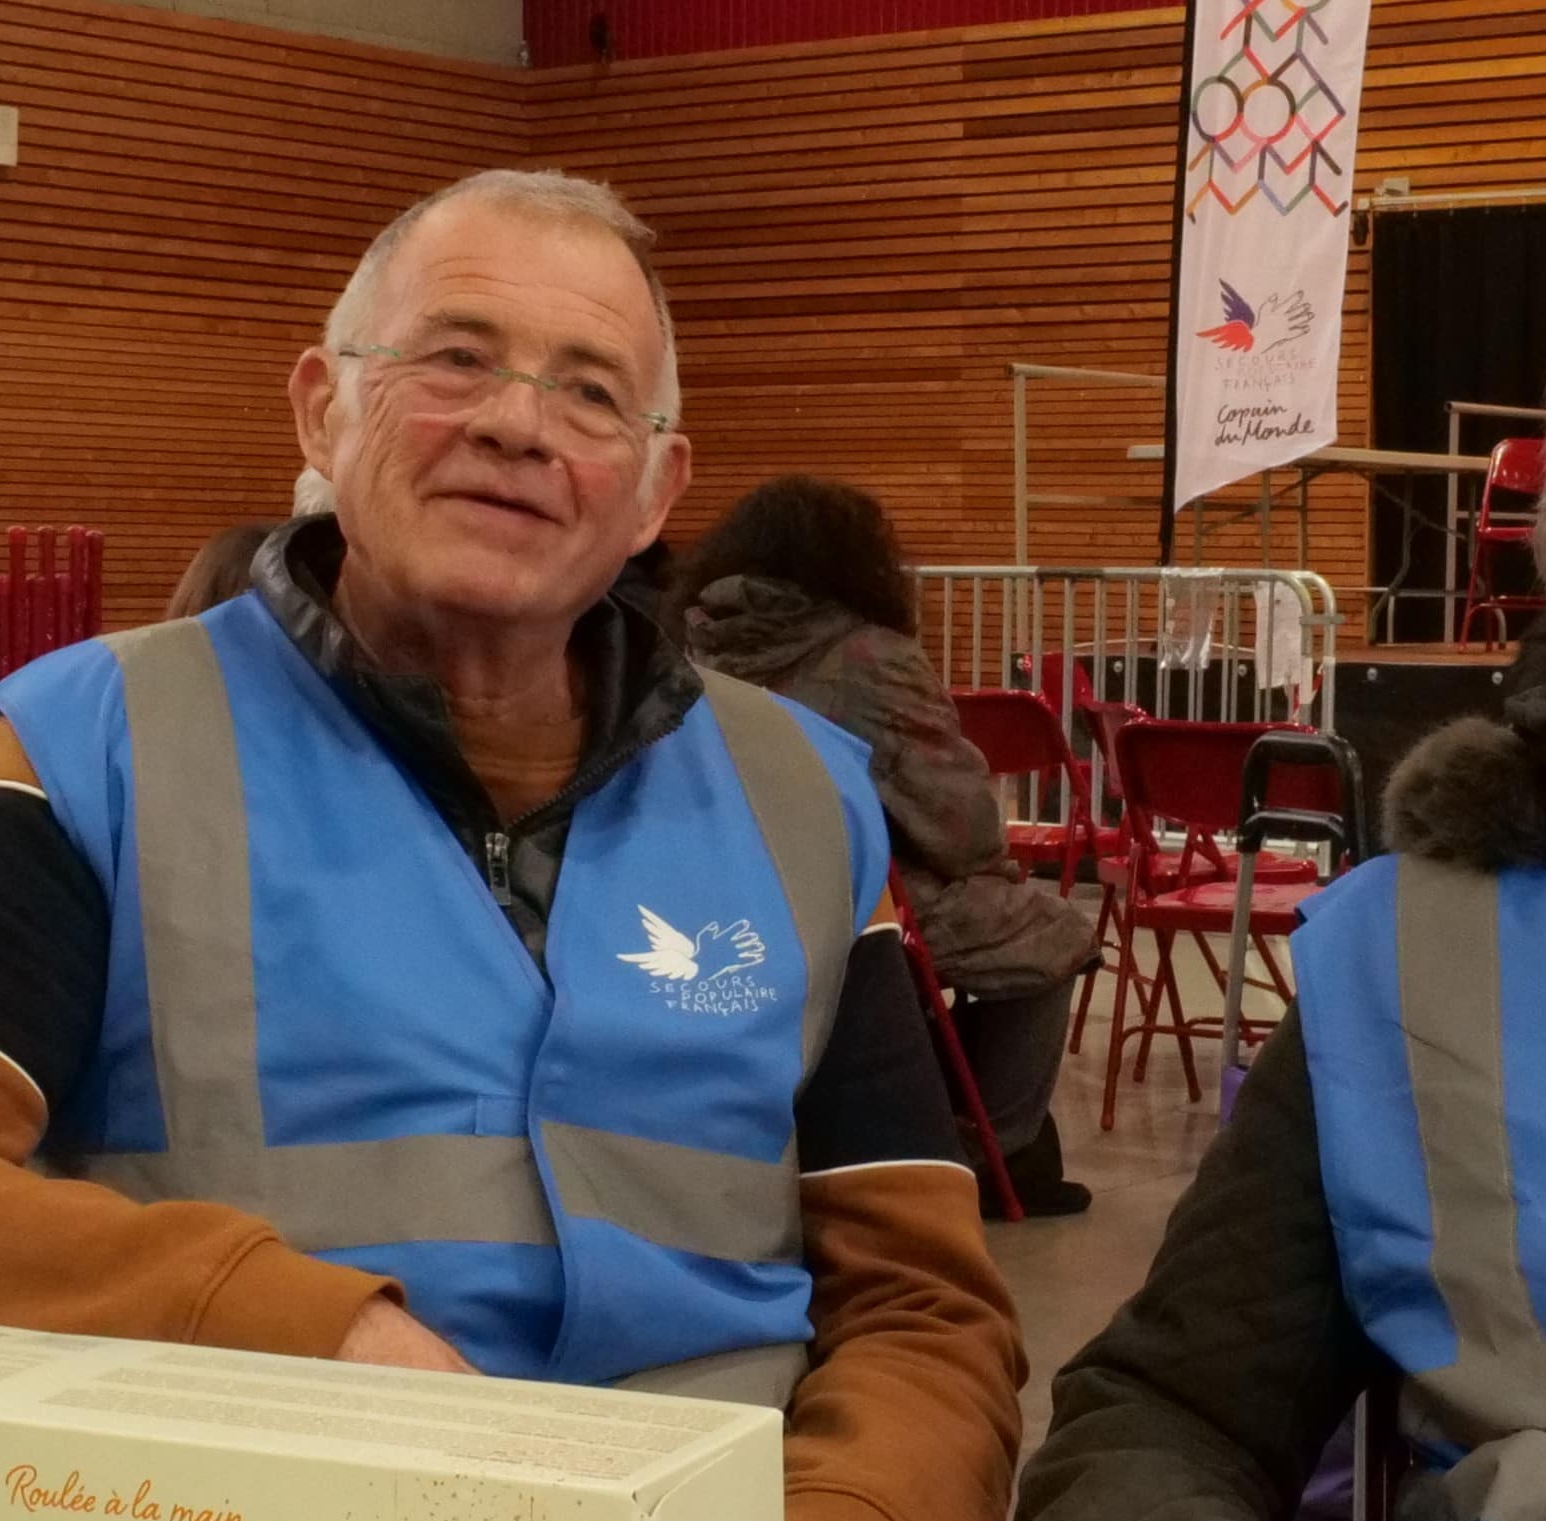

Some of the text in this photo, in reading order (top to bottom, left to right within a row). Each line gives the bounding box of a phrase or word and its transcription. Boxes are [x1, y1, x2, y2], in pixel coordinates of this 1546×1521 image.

[1217, 399, 1288, 427] Copain
[1215, 412, 1314, 446] du Monde
[650, 975, 755, 994] SECOURS
[682, 987, 778, 1003] POPULAIRE
[665, 998, 759, 1016] FRANÇAIS
[5, 1464, 97, 1514] Roulée
[104, 1485, 129, 1517] à
[130, 1479, 162, 1521] la
